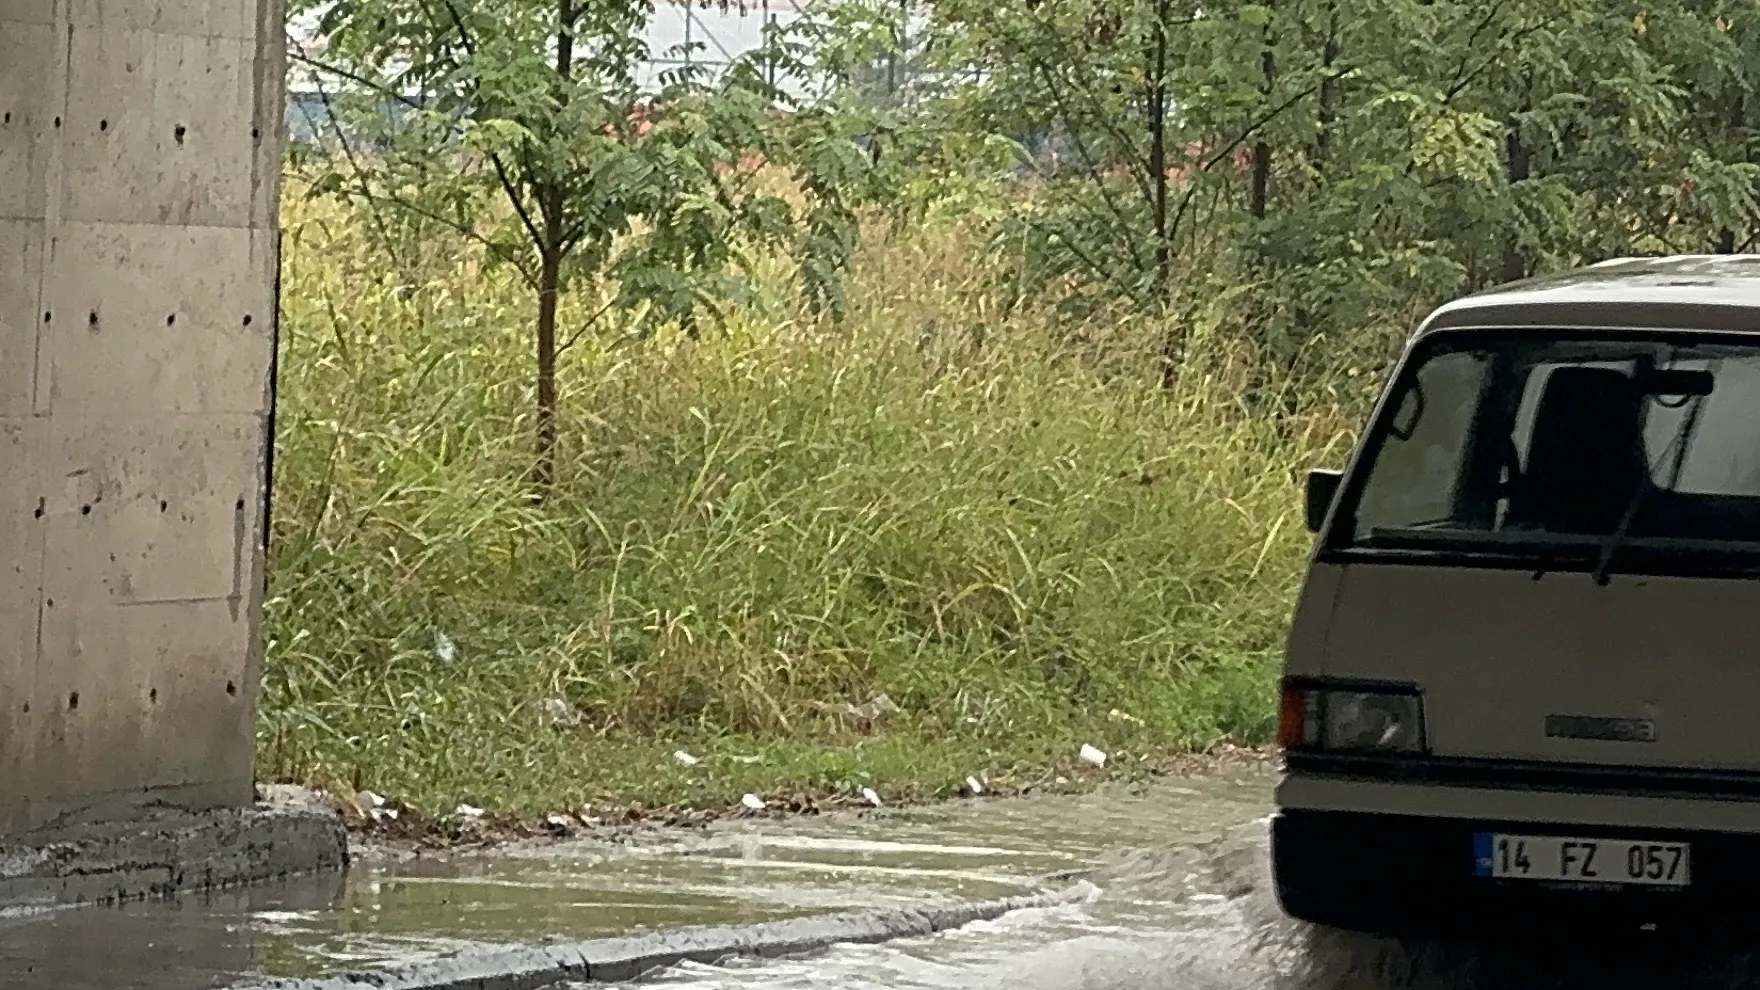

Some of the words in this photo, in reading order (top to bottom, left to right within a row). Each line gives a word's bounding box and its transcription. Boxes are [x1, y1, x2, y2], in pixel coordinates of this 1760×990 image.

[1498, 838, 1531, 875] 14
[1560, 842, 1598, 878] FZ
[1627, 844, 1682, 881] 057
